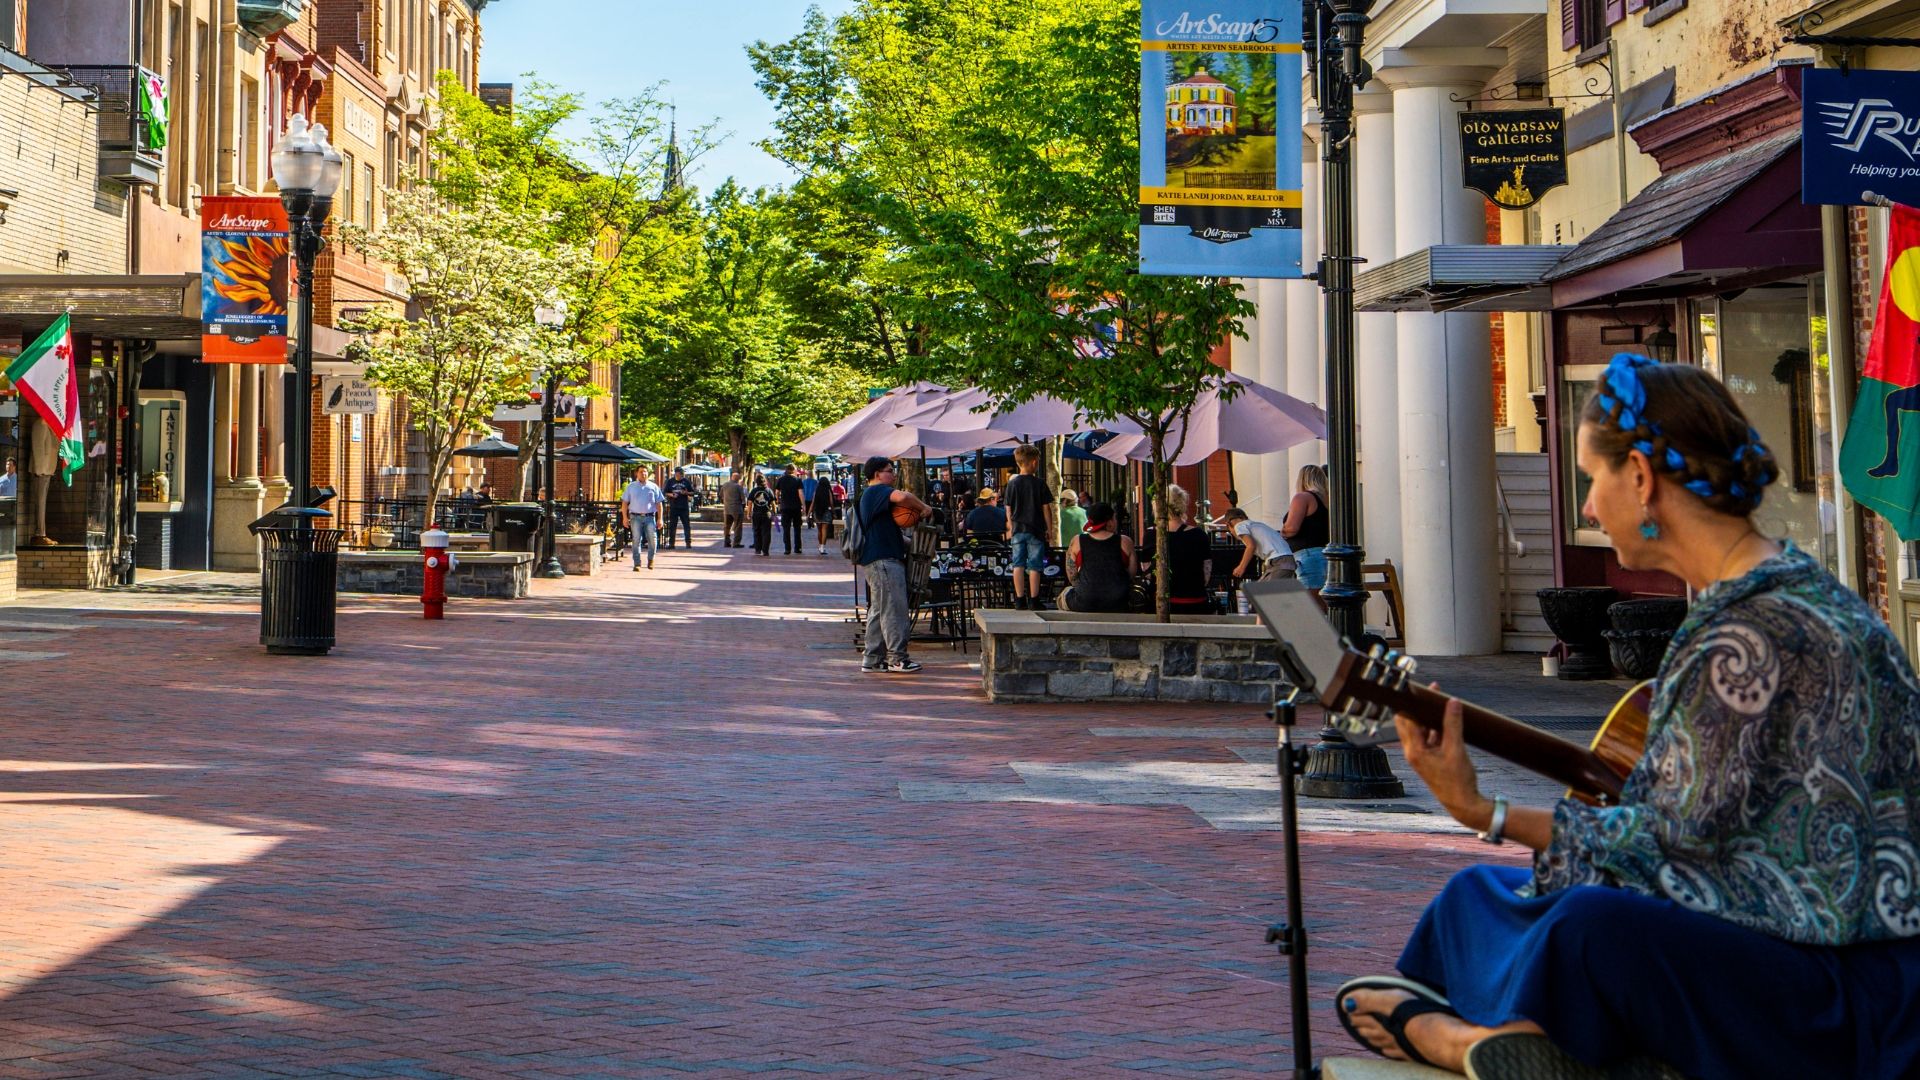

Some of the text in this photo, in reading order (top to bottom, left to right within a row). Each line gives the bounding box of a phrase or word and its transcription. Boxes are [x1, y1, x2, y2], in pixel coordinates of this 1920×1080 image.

[1155, 11, 1283, 43] ArtScape 15
[1201, 43, 1227, 51] KEVIN
[1228, 44, 1277, 52] SEABROOKE
[1464, 121, 1560, 134] OLD WARSAW
[1478, 134, 1552, 147] GALLERIES
[1470, 153, 1559, 164] Fine Arts and Crafts
[1849, 164, 1897, 178] Helping
[1157, 191, 1285, 202] KATIE LANDI JORDAN, REALTOR
[1153, 205, 1176, 213] SHEN
[209, 213, 269, 231] ArtScape
[1154, 213, 1175, 221] arts
[1267, 218, 1286, 226] MSV
[352, 380, 367, 389] Blue
[345, 388, 373, 397] Peacock
[345, 398, 374, 409] Antiques
